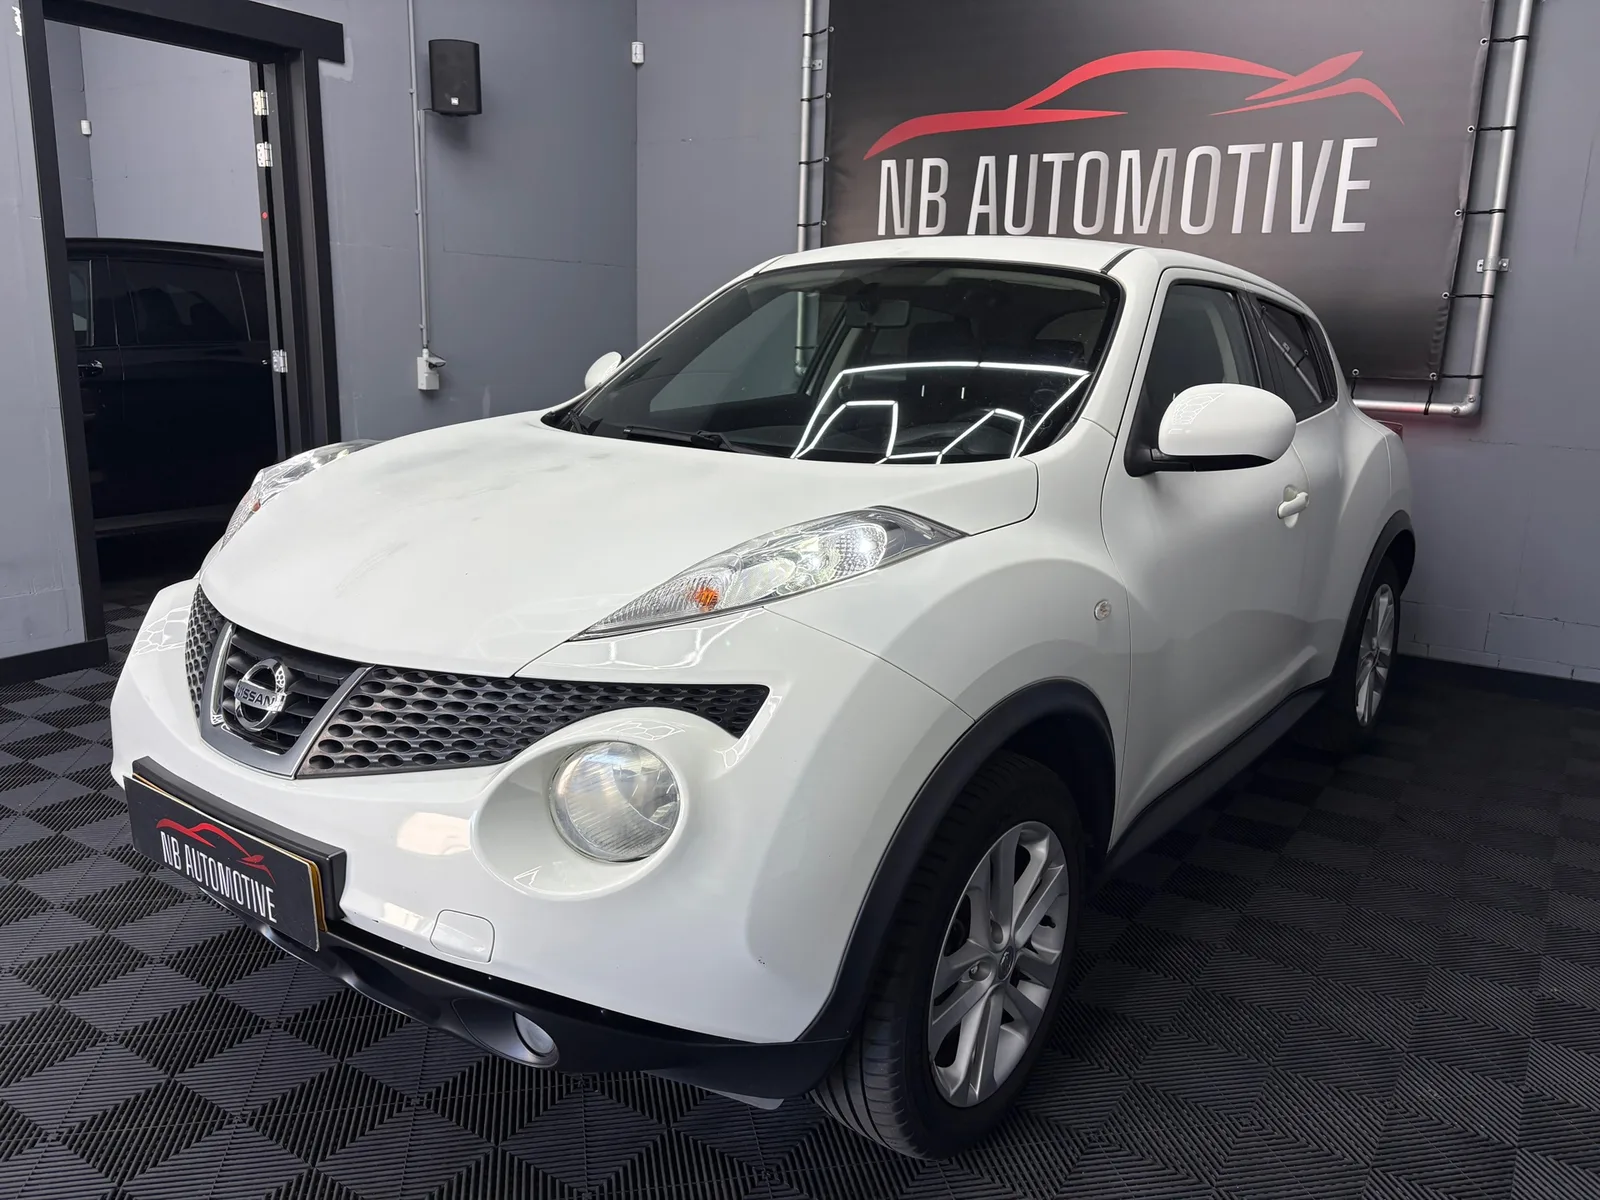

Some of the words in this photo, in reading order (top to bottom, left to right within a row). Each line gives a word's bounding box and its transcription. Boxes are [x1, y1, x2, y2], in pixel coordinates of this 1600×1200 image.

[877, 158, 949, 236] NB
[967, 137, 1379, 235] AUTOMOTIVE
[160, 831, 182, 871] NB
[184, 843, 277, 923] AUTOMOTIVE
